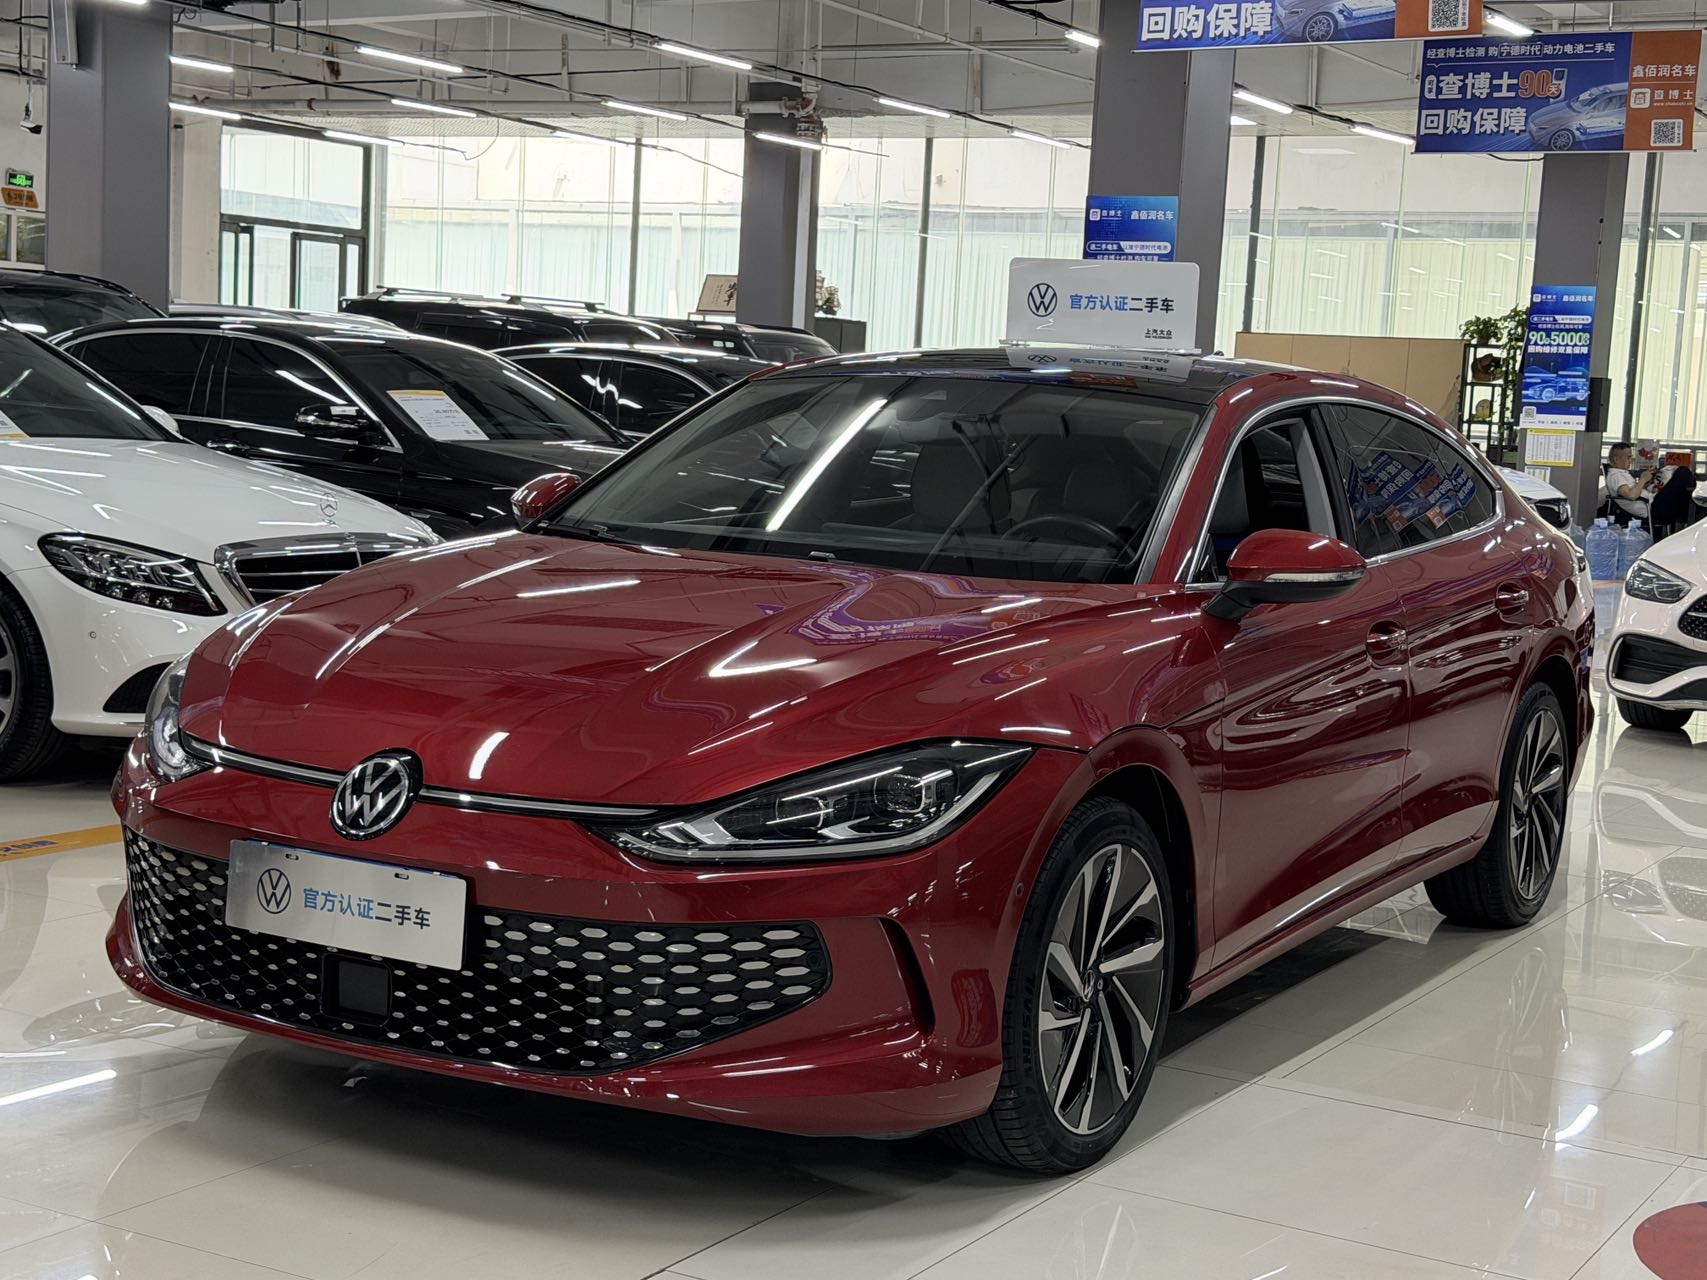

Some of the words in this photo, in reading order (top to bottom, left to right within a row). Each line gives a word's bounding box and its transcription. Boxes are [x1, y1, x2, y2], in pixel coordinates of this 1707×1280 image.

[1141, 1, 1273, 41] 回购保障
[1426, 46, 1485, 59] 经查博士检测
[1488, 46, 1498, 57] 购
[1500, 44, 1541, 56] 宁德时代
[1543, 42, 1615, 54] 动力电池二手车
[1632, 64, 1697, 78] 鑫佰润名车
[1654, 89, 1694, 100] 查博士
[1419, 106, 1527, 136] 回购保障
[1069, 294, 1174, 314] 官方认证二手车
[303, 887, 431, 930] 官方认证二手车
